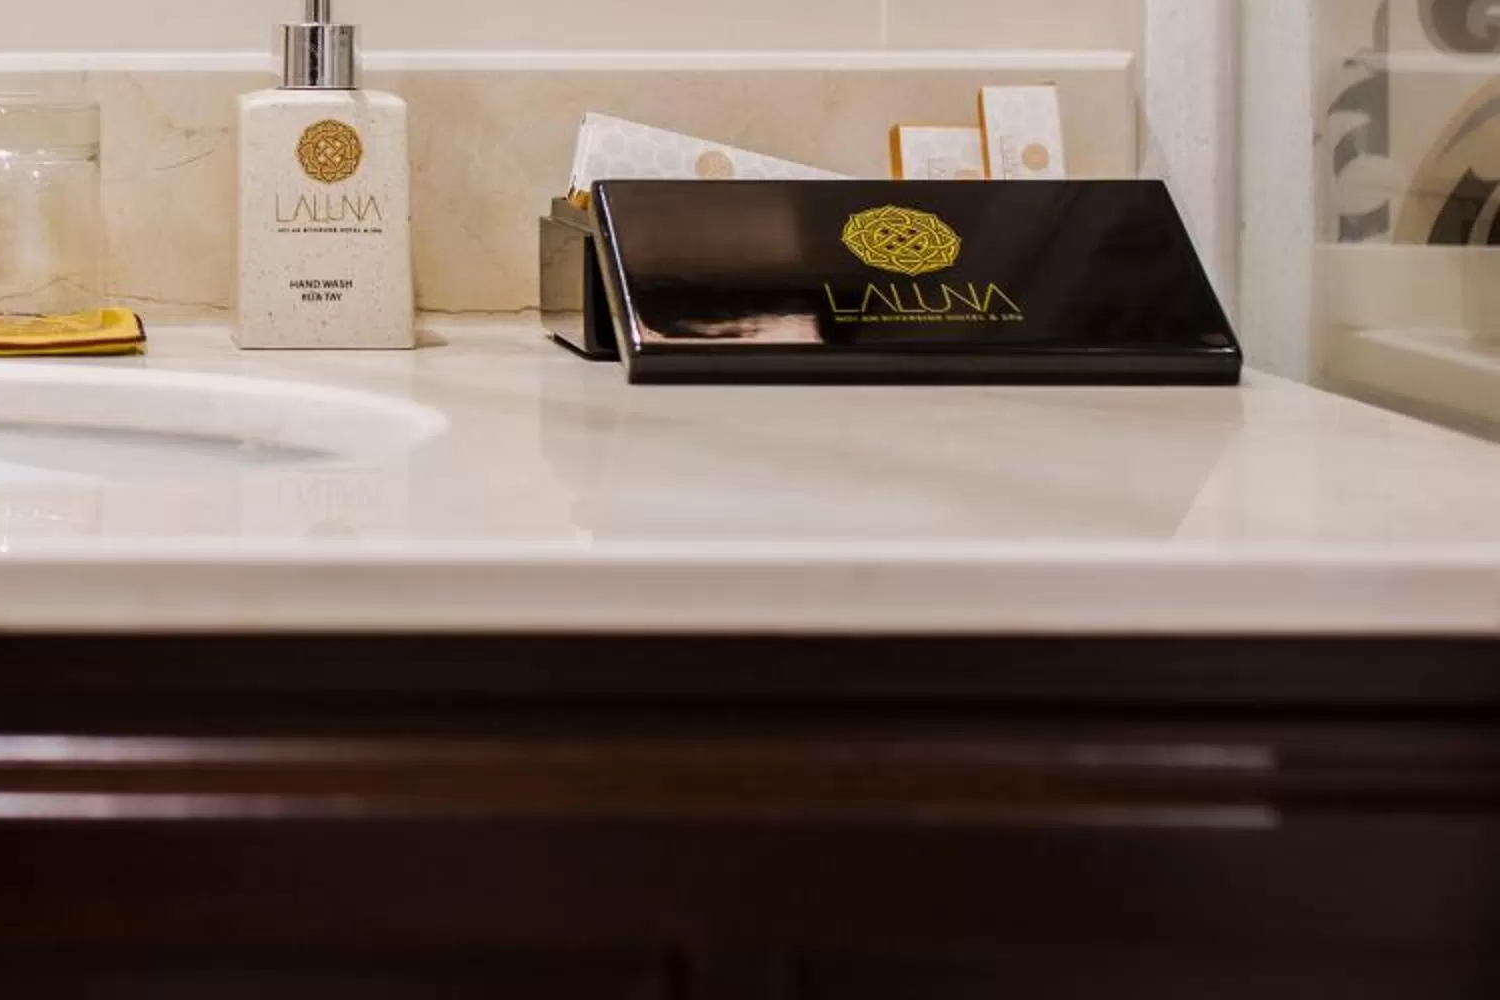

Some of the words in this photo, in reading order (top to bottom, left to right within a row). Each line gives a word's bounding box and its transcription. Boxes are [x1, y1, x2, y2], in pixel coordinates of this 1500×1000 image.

[275, 192, 383, 223] LALUNA
[289, 279, 321, 289] HAND
[322, 279, 353, 289] WASH
[324, 292, 343, 301] TAY
[823, 281, 1022, 313] LALUNA
